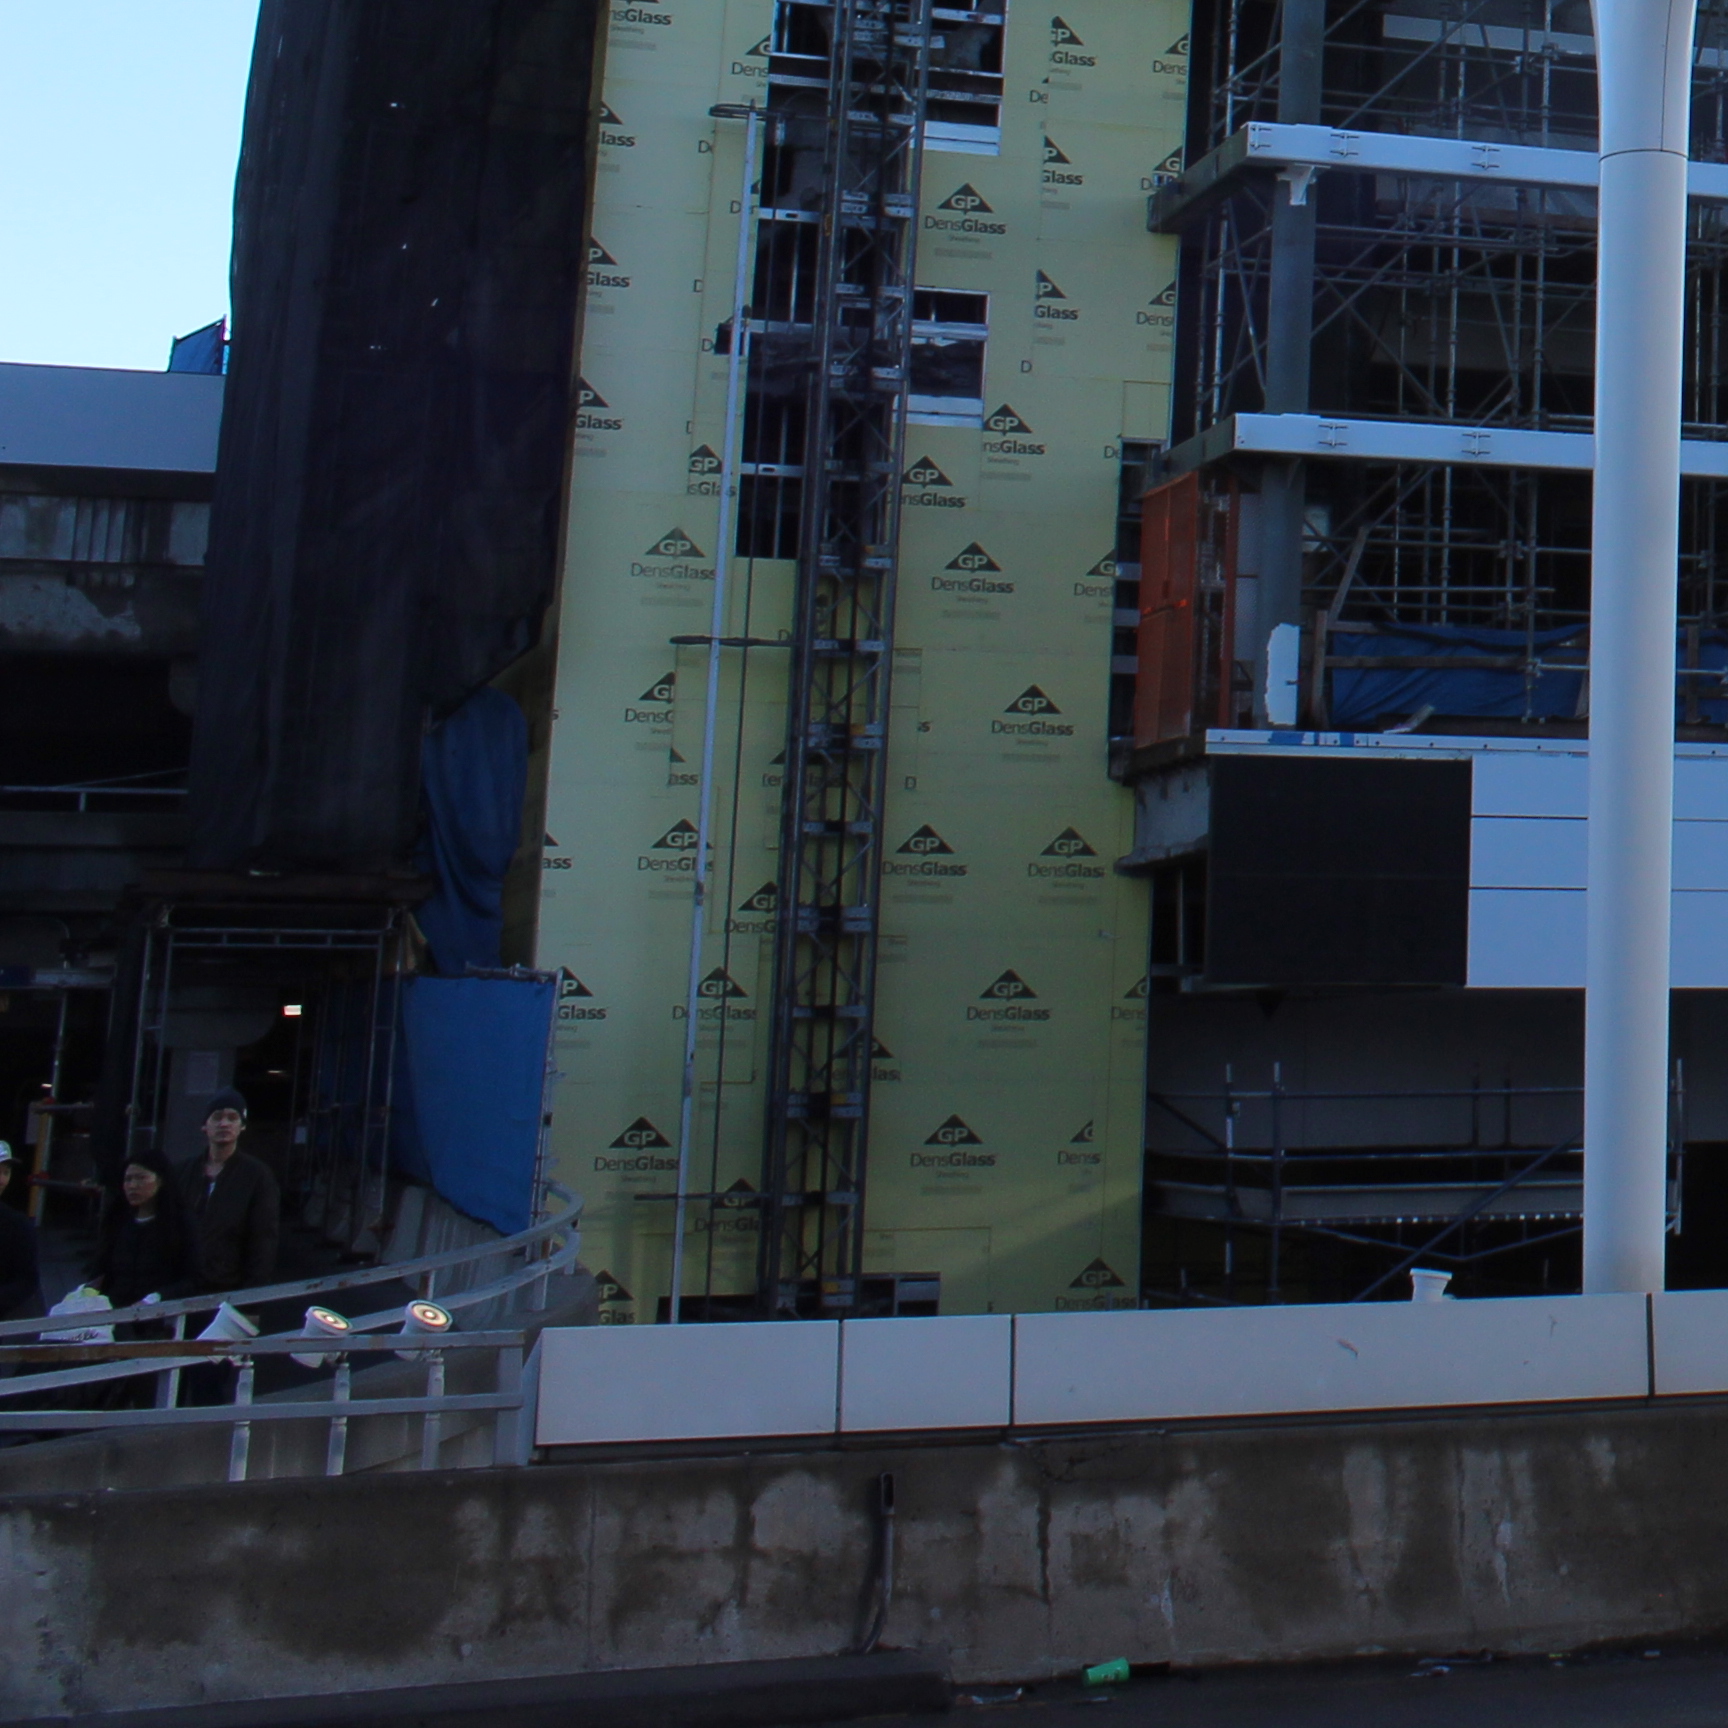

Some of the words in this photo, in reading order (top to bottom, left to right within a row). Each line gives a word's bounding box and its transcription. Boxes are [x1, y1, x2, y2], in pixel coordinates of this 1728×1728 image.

[611, 8, 672, 26] nsGlass
[1051, 51, 1096, 67] Glass
[1042, 170, 1083, 185] Glass
[950, 194, 981, 210] GP
[924, 214, 1006, 235] DensGlass
[586, 272, 630, 288] Glass
[1034, 304, 1080, 321] Glass
[575, 414, 622, 431] Glass
[990, 416, 1020, 432] GP
[983, 438, 1046, 456] nsGlass
[909, 467, 940, 482] GP
[660, 539, 691, 554] GP
[958, 555, 988, 570] GP
[932, 576, 1014, 594] DensGlass
[1017, 696, 1048, 712] GP
[991, 719, 1074, 737] DensGlass
[667, 832, 698, 847] GP
[909, 836, 940, 852] GP
[1054, 838, 1084, 853] GP
[562, 981, 578, 998] P
[994, 980, 1023, 997] GP
[558, 1004, 606, 1022] Glass
[967, 1006, 1049, 1024] DensGlass
[624, 1129, 656, 1146] GP
[936, 1129, 967, 1144] GP
[911, 1153, 995, 1167] DensGlass
[1081, 1271, 1112, 1287] GP
